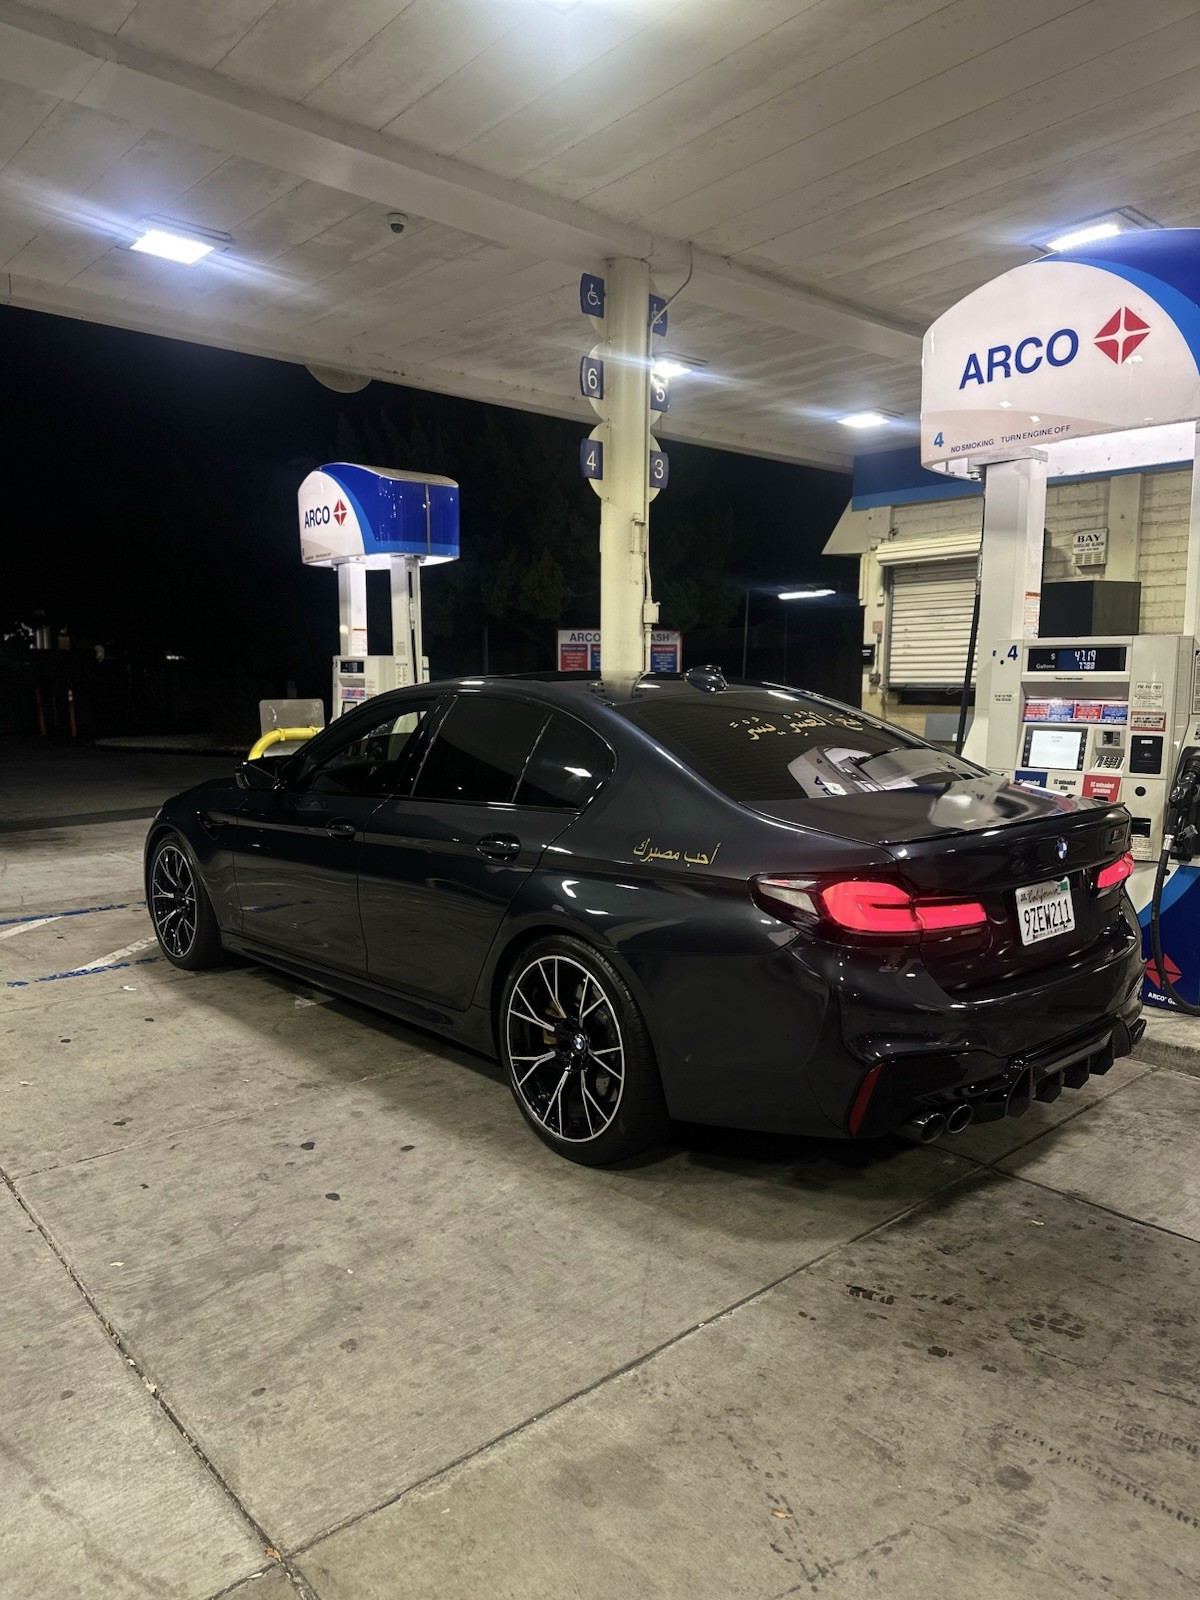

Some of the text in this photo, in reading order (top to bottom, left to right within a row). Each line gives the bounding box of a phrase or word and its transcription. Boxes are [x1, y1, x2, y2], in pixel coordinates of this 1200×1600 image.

[958, 328, 1079, 391] ARCO
[588, 368, 597, 390] 6
[656, 382, 665, 402] 5
[933, 431, 945, 448] 4
[950, 424, 1072, 454] NO SMOKING TURN ENGINE OFF
[587, 451, 596, 471] 4
[654, 459, 664, 479] 3
[304, 505, 331, 529] ARCO
[1077, 533, 1102, 543] BAY
[569, 632, 670, 642] ARCO ASH
[1007, 644, 1018, 661] 4
[1028, 886, 1061, 904] California
[1023, 898, 1072, 936] 9ZEW211
